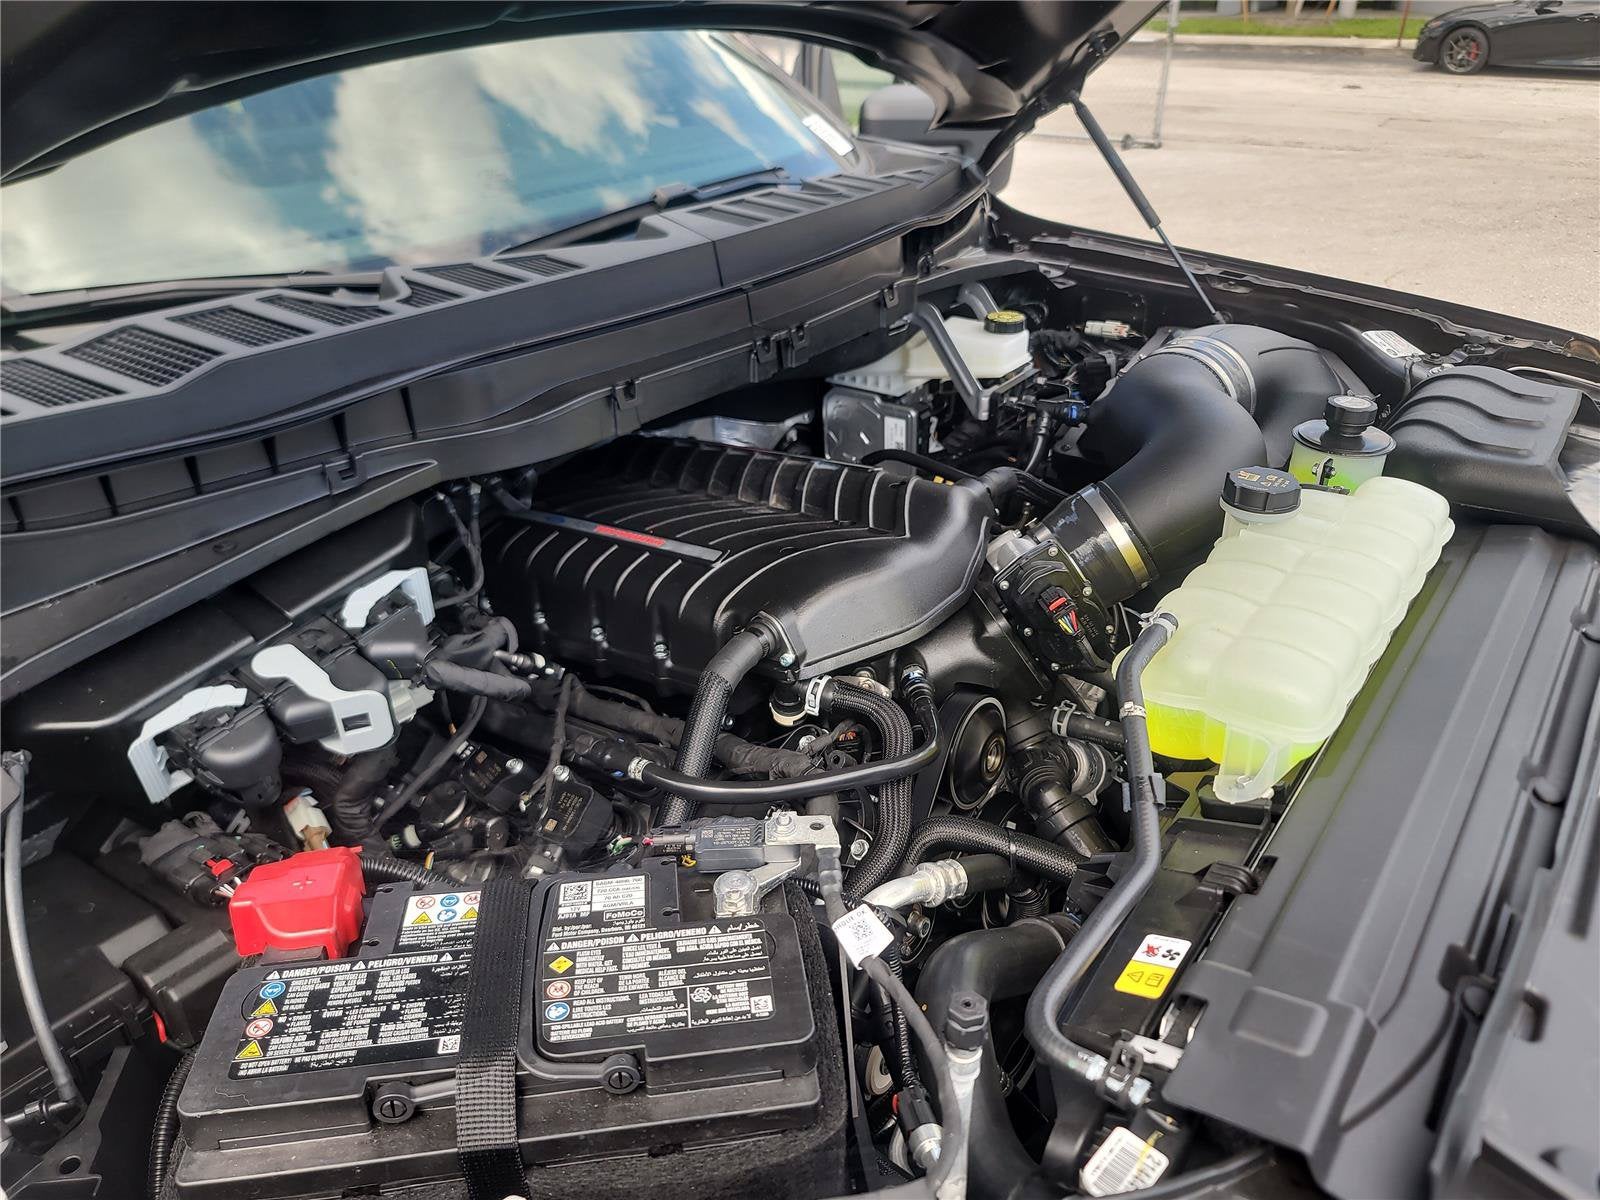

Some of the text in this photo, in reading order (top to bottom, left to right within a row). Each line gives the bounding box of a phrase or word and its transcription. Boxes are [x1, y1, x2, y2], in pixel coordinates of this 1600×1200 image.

[605, 909, 642, 918] FoMoCo
[640, 927, 706, 940] PELIGRO/VENENO
[561, 936, 624, 949] DANGER/POISON
[367, 953, 438, 968] PELIGRO/VENENO
[281, 963, 351, 978] DANGER/POISON
